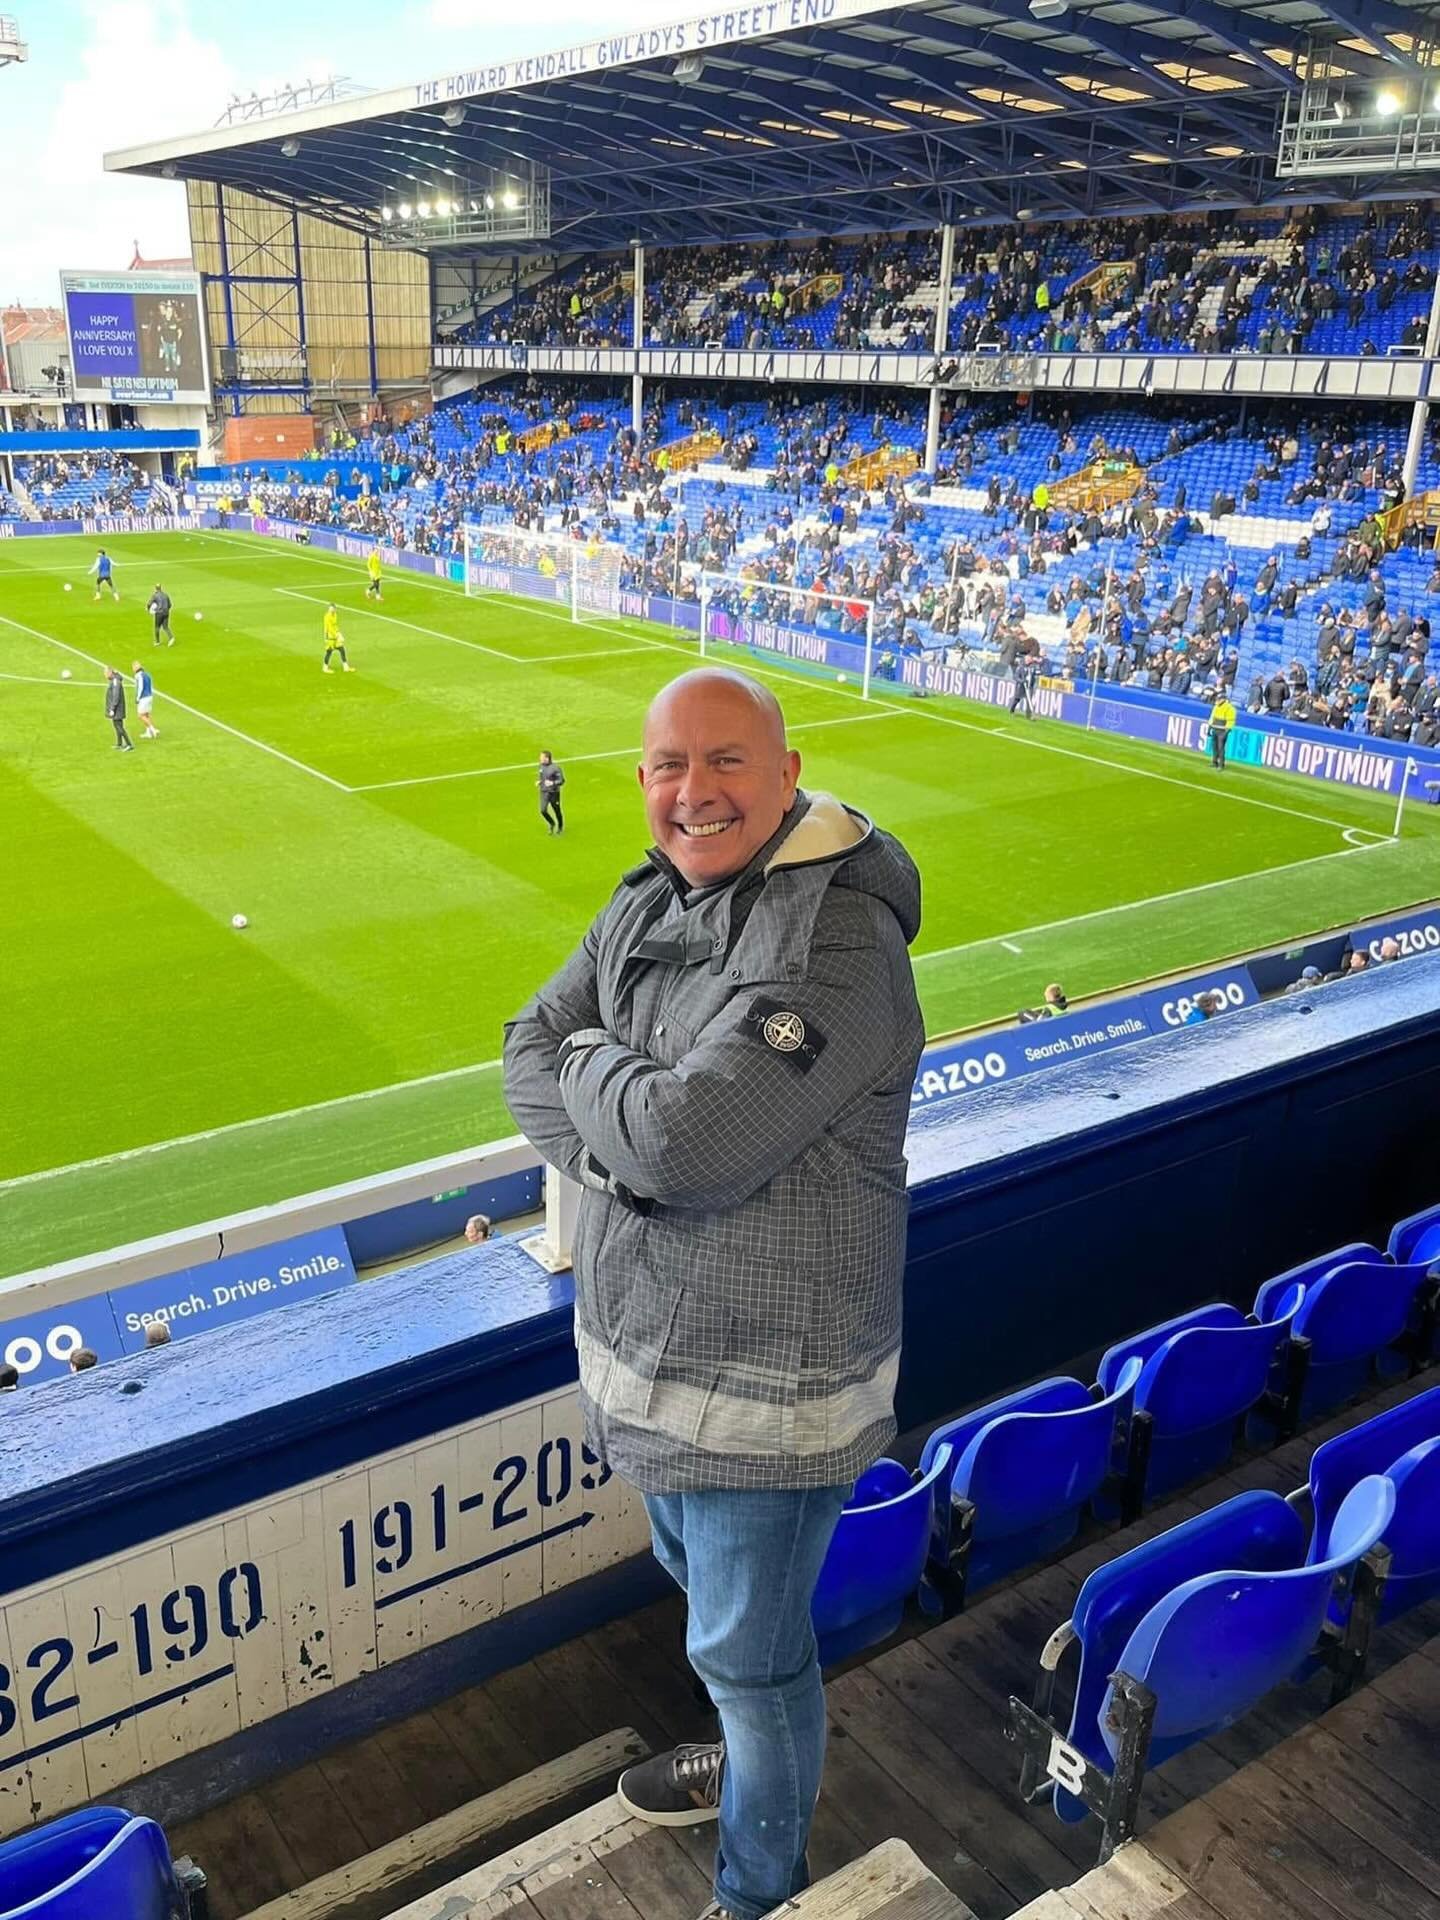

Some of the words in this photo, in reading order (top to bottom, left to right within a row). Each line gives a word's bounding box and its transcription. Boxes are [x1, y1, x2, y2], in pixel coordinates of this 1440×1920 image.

[415, 80, 439, 104] THE
[446, 67, 507, 95] HOWARD
[514, 48, 587, 83] KENDALL
[597, 23, 685, 65] GWLADYS
[697, 3, 777, 44] STREET
[791, 0, 835, 25] END
[73, 330, 136, 341] ANNIVERSARY!
[90, 315, 119, 326] HAPPY
[83, 345, 106, 356] LOVE
[107, 345, 126, 356] YOU
[127, 346, 133, 356] X
[196, 482, 242, 494] CAZOO
[82, 518, 97, 535] NIL
[101, 517, 130, 533] SATIS
[132, 515, 152, 531] NISI
[754, 623, 775, 649] NISI
[777, 628, 828, 663] OPTIMUM
[903, 659, 922, 686] NIL
[926, 662, 963, 695] SATIS
[965, 673, 993, 703] NISI
[996, 678, 1063, 718] OPMUM
[1166, 716, 1192, 748] NIL
[1197, 724, 1249, 762] SIS
[1257, 735, 1293, 769] NISI
[1297, 743, 1394, 791] OPTIMUM
[1368, 924, 1440, 961] CZOO
[1024, 1036, 1073, 1062] Search.
[1071, 1029, 1108, 1049] Drive.
[1107, 1017, 1147, 1039] Smile.
[125, 1296, 212, 1333] Search.
[212, 1279, 277, 1307] Drive.
[279, 1254, 346, 1286] Smile.
[1046, 1736, 1086, 1796] B
